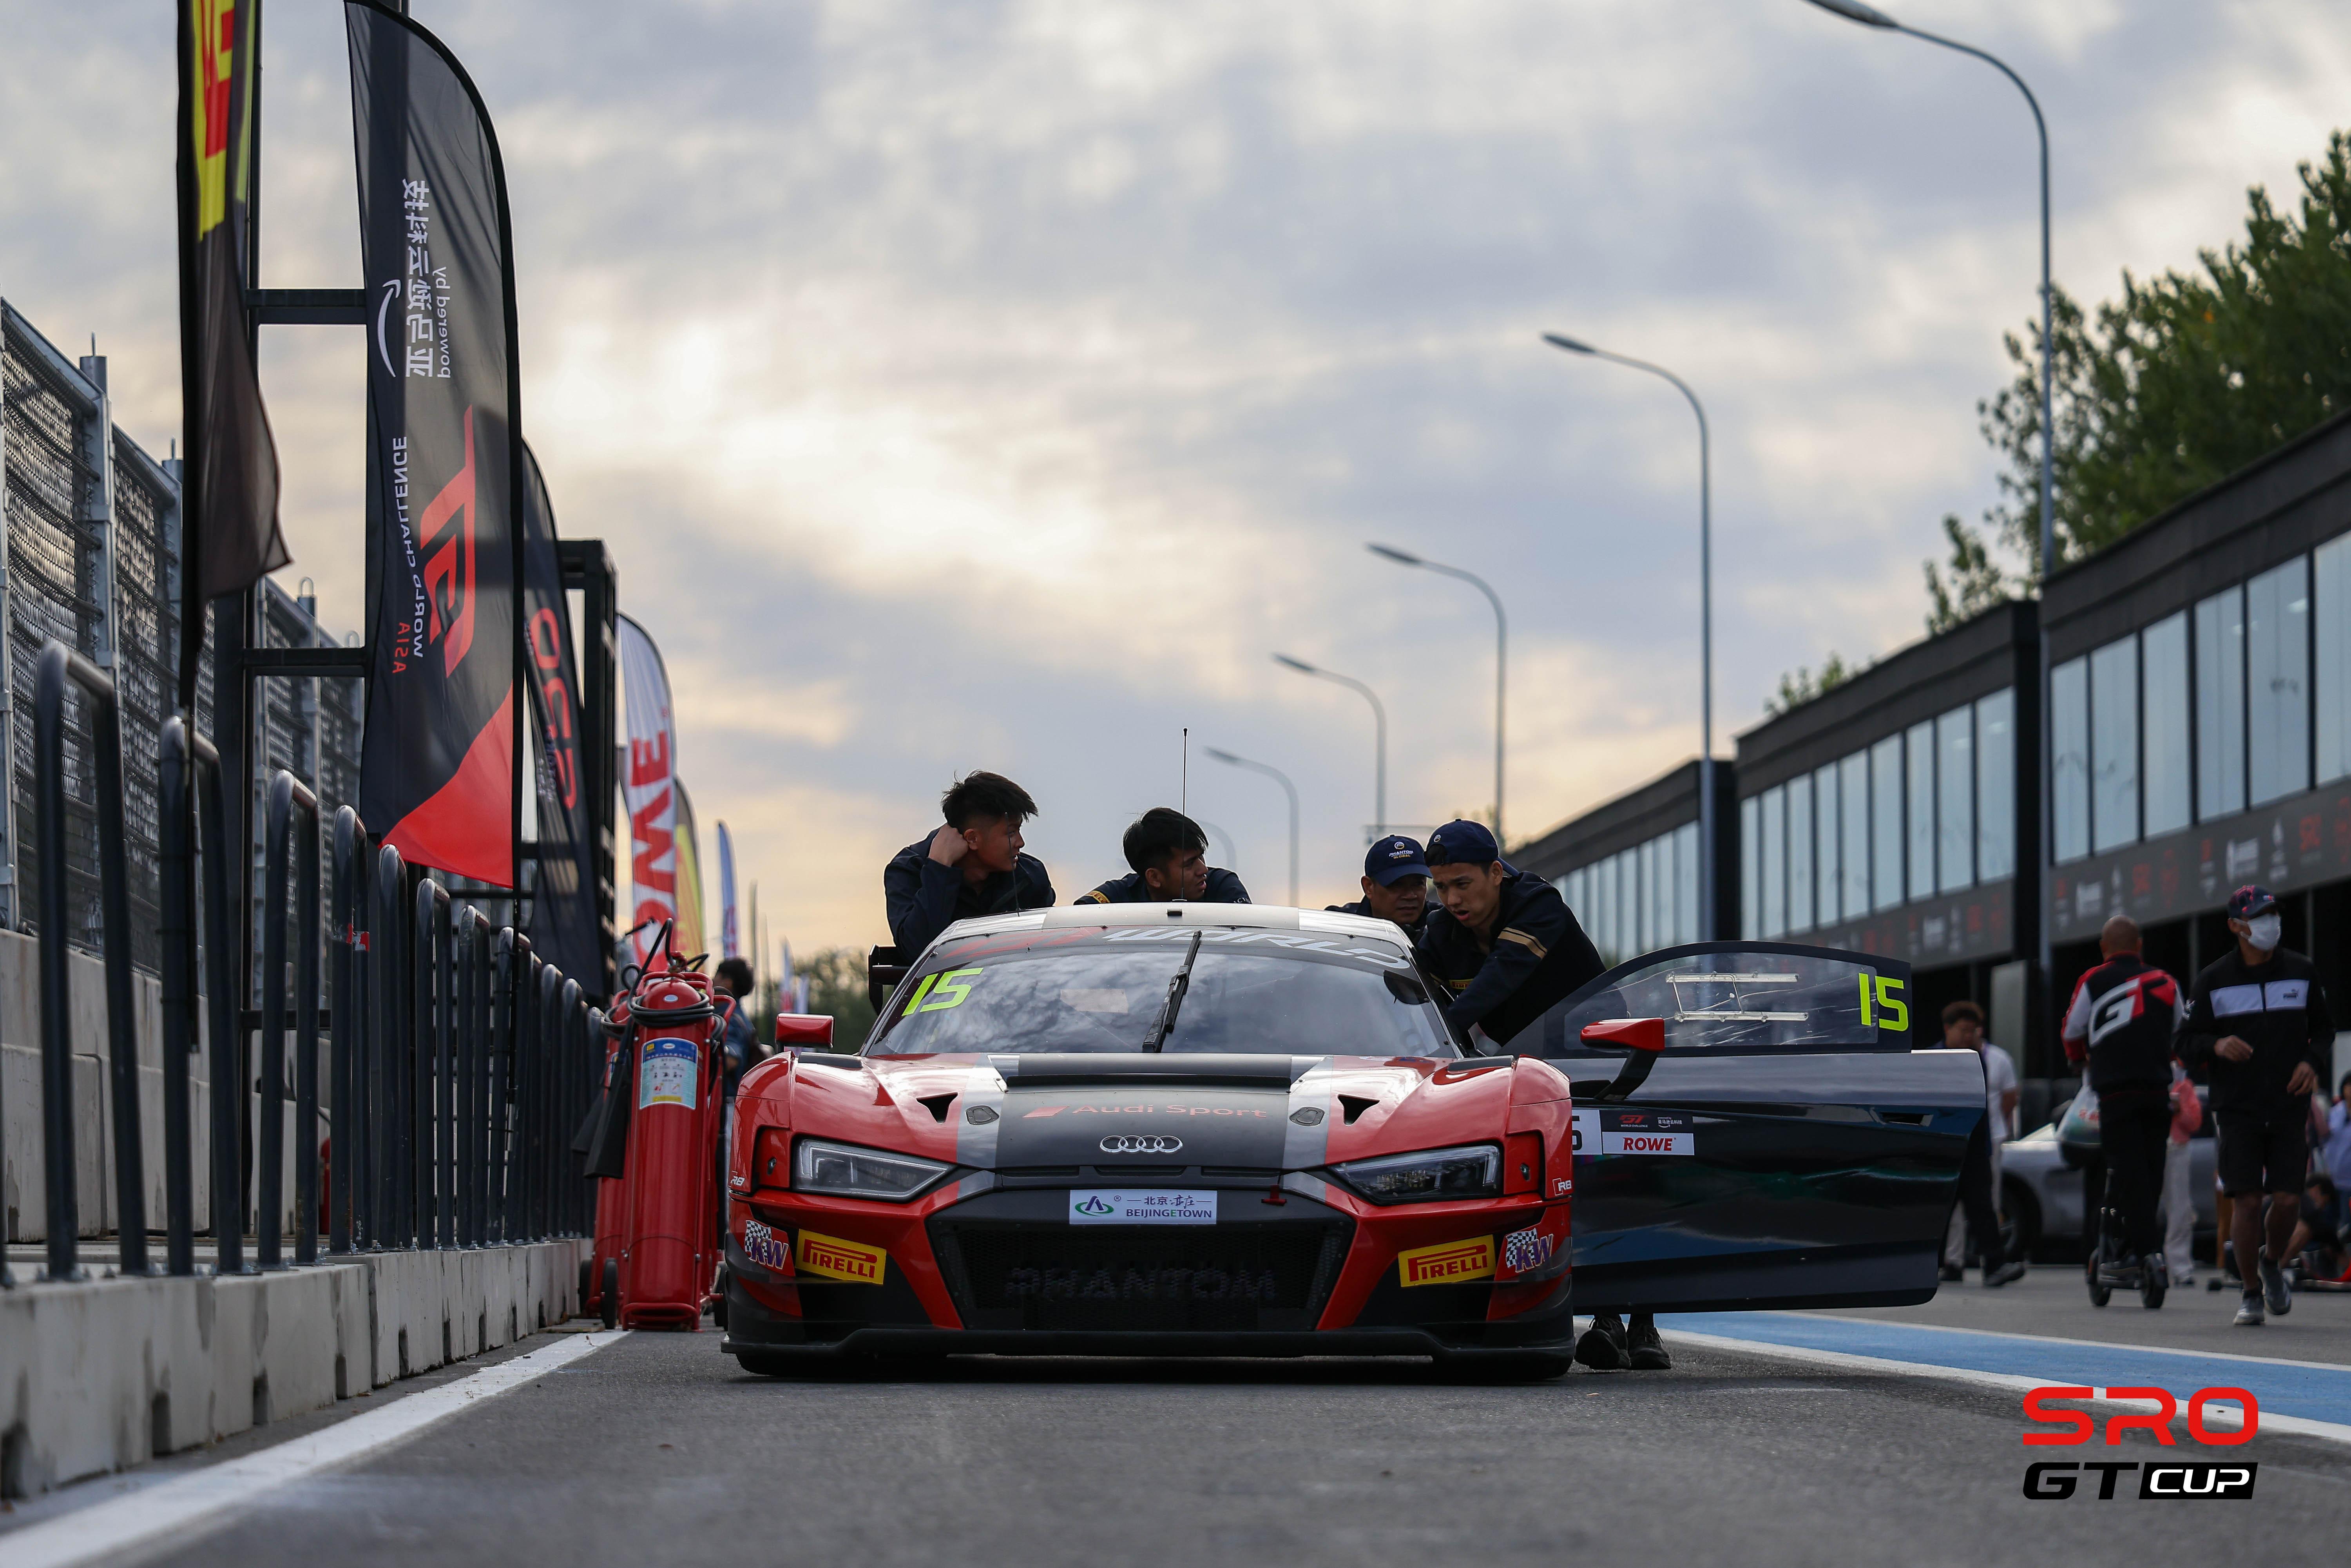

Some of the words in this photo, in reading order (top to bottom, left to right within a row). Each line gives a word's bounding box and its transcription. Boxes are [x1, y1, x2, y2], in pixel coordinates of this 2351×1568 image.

[901, 967, 984, 1016] 15
[1858, 972, 1909, 1032] 15
[1072, 1104, 1154, 1114] Audi
[1165, 1104, 1267, 1118] Sport
[1623, 1137, 1673, 1151] ROWE
[730, 1175, 745, 1186] R8
[1558, 1179, 1572, 1191] R8
[1126, 1209, 1212, 1218] BEIJINGETOWN
[749, 1235, 789, 1270] KW
[802, 1238, 878, 1278] PIRELLI
[1407, 1244, 1488, 1282] PIRELLI
[1515, 1233, 1554, 1273] KW
[1004, 1267, 1277, 1299] PHANTOM
